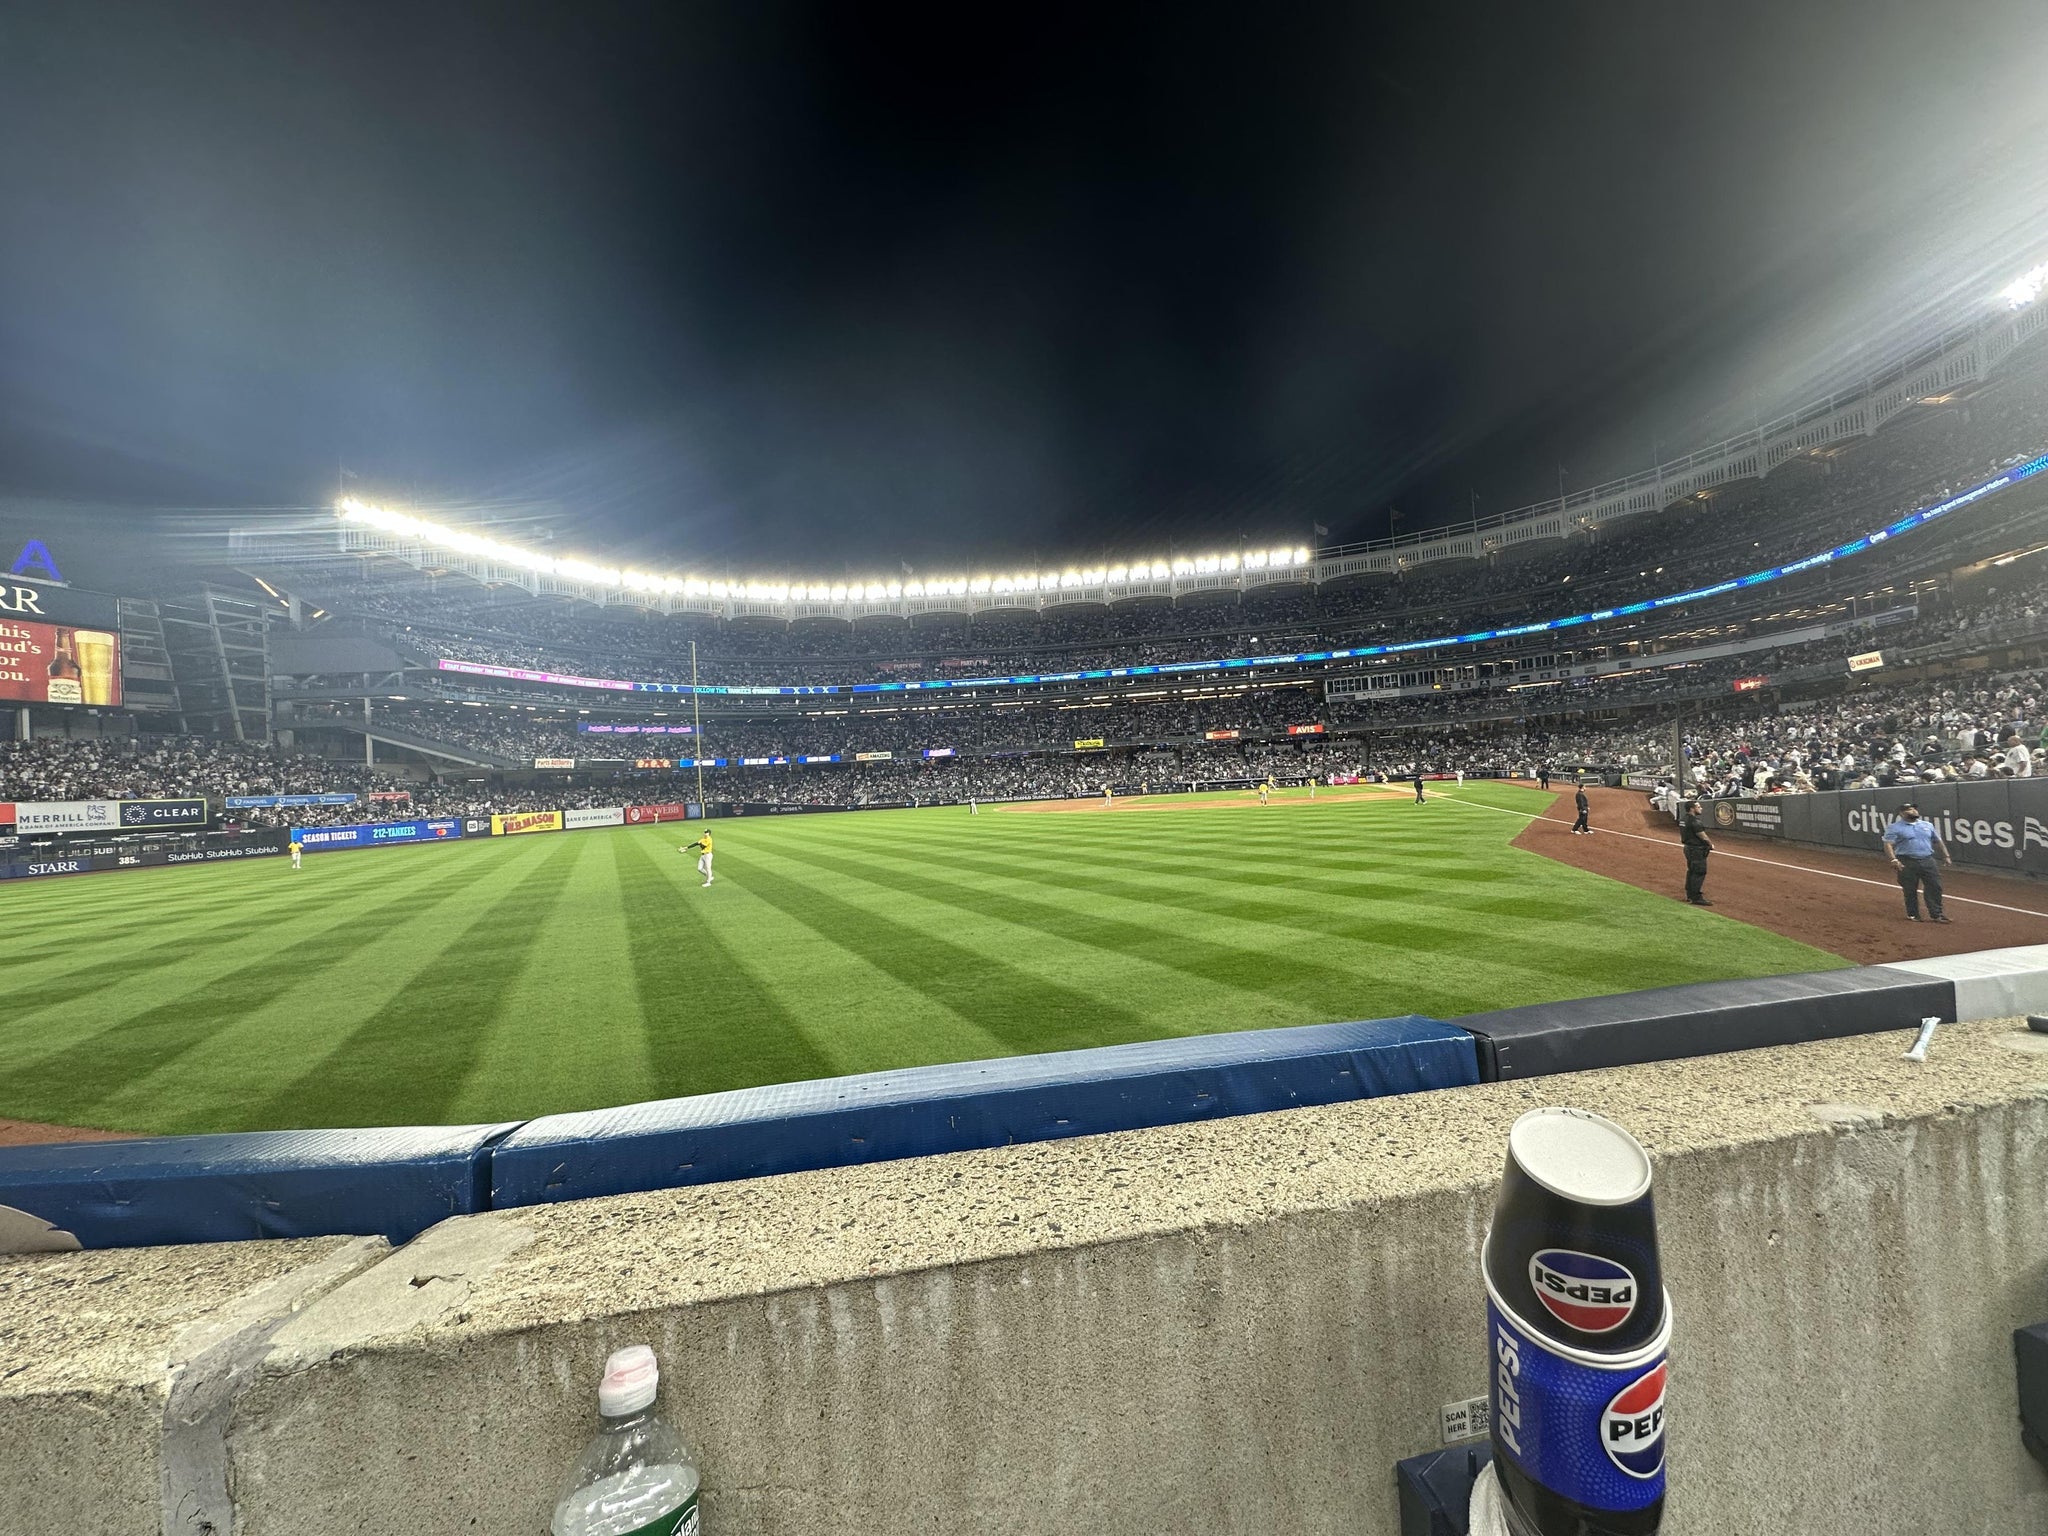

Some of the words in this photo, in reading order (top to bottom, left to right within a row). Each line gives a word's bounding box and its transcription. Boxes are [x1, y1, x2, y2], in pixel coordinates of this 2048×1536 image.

[20, 814, 83, 823] MERRILL
[154, 808, 199, 817] CLEAR
[302, 833, 329, 843] SEASON
[331, 831, 357, 841] TICKETS
[373, 826, 416, 838] 212-YANKEES
[168, 852, 203, 862] StubHub
[207, 848, 242, 858] StubHub
[245, 846, 278, 855] StubHub
[119, 857, 135, 865] 385
[28, 861, 79, 875] STARR
[1535, 1267, 1632, 1304] PEPSI
[1497, 1323, 1521, 1456] PEPSI
[1445, 1410, 1466, 1422] SCAN
[1447, 1422, 1467, 1433] HERE
[1609, 1405, 1664, 1441] PEP
